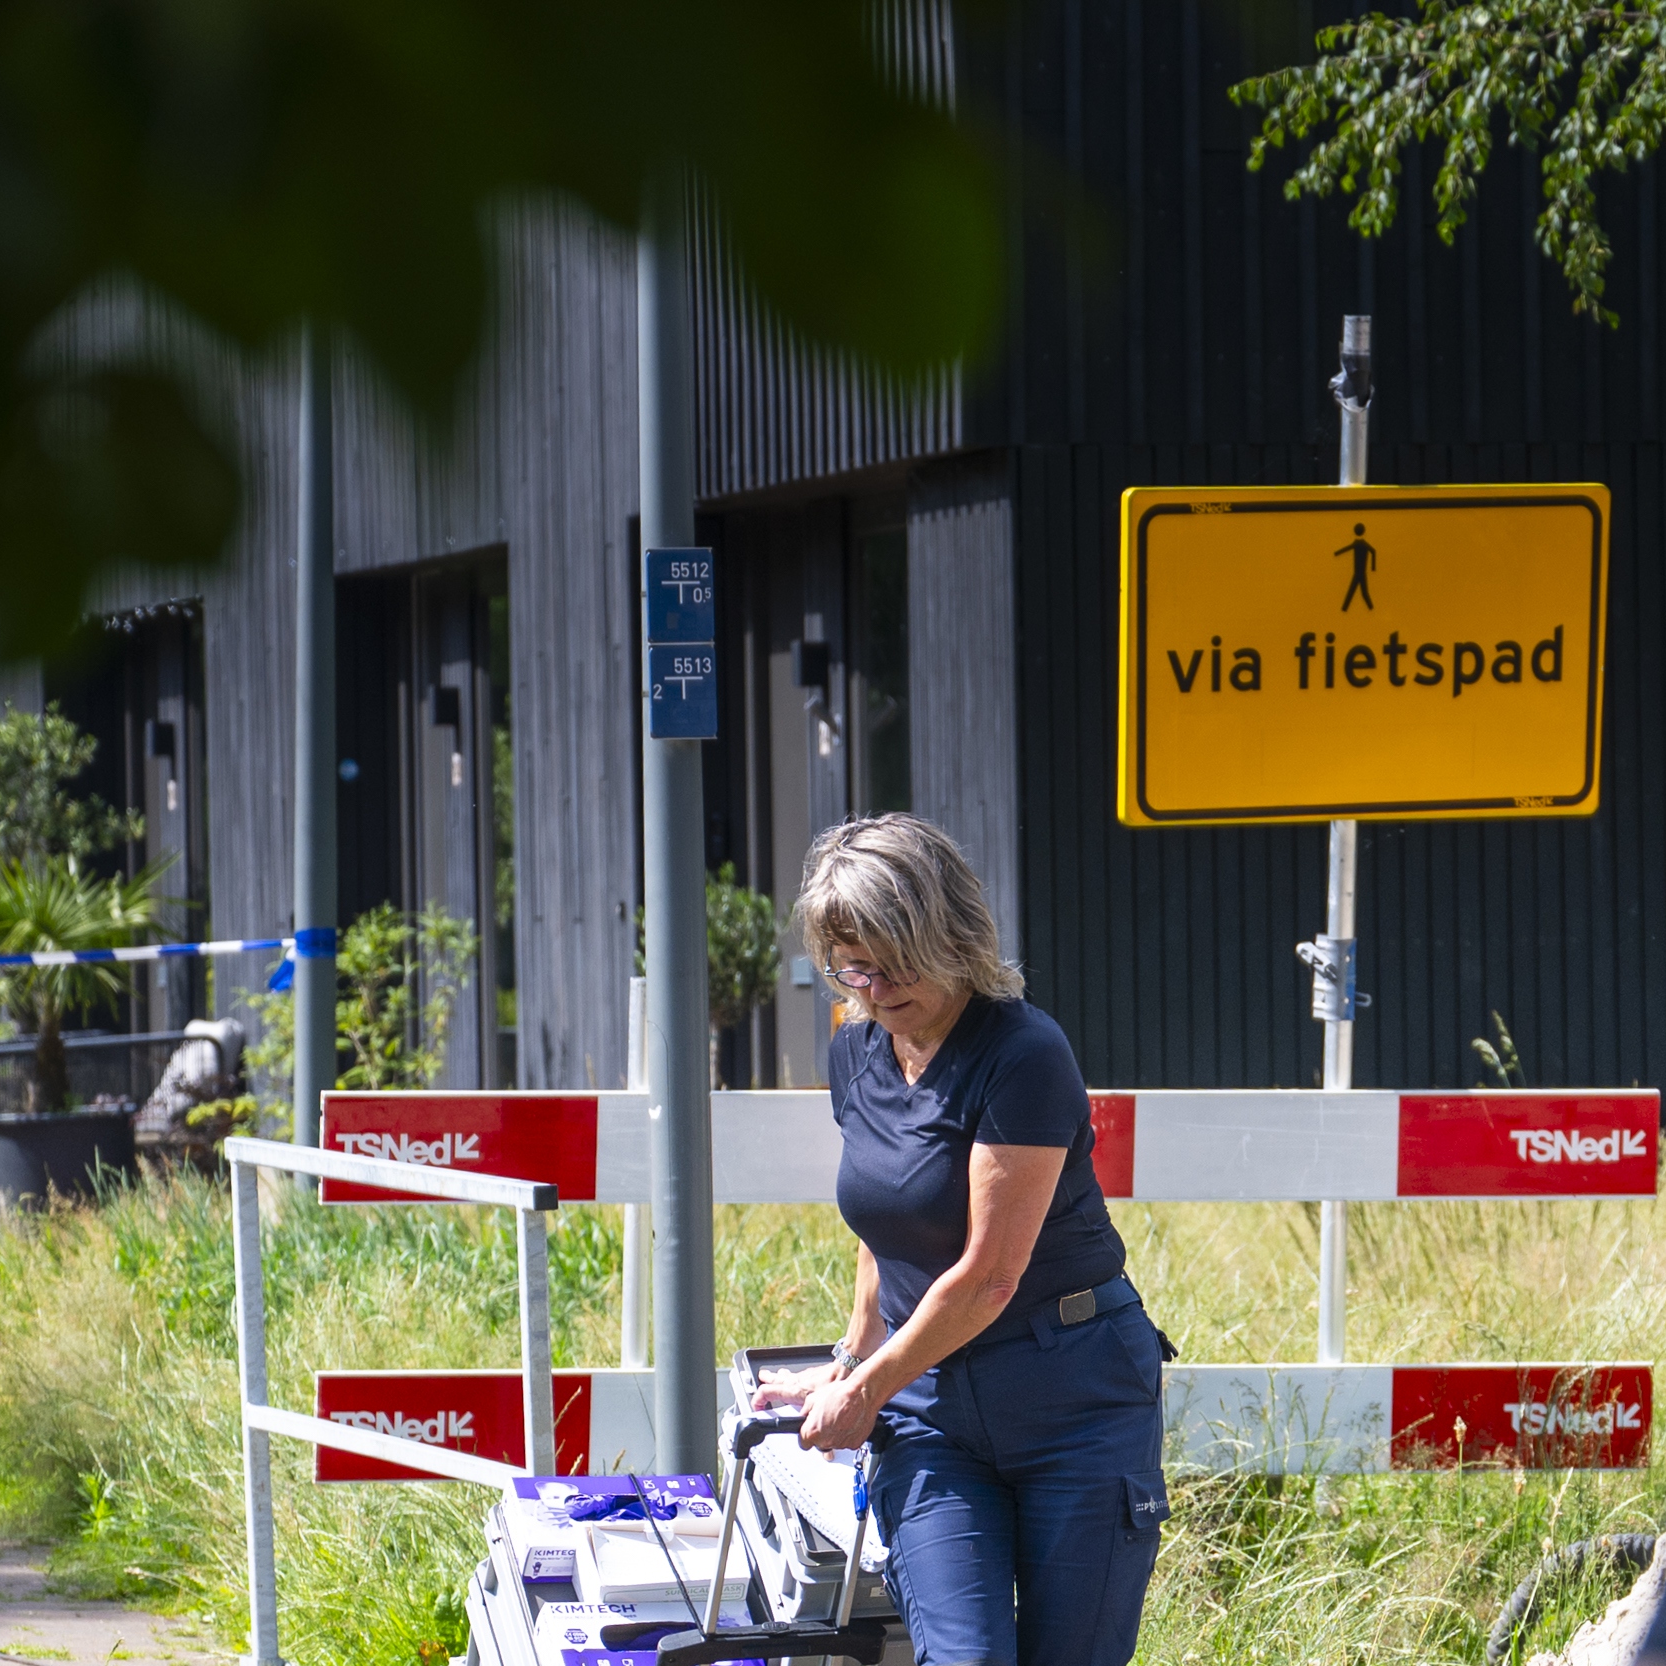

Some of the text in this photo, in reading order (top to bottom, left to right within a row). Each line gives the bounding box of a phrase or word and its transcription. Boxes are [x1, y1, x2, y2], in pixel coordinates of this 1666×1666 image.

[671, 562, 709, 578] 5512
[674, 657, 712, 674] 5513
[1166, 624, 1564, 698] via fietspad
[653, 684, 662, 699] 2
[1509, 1130, 1620, 1162] TSNed
[550, 1604, 637, 1614] KIMTECH
